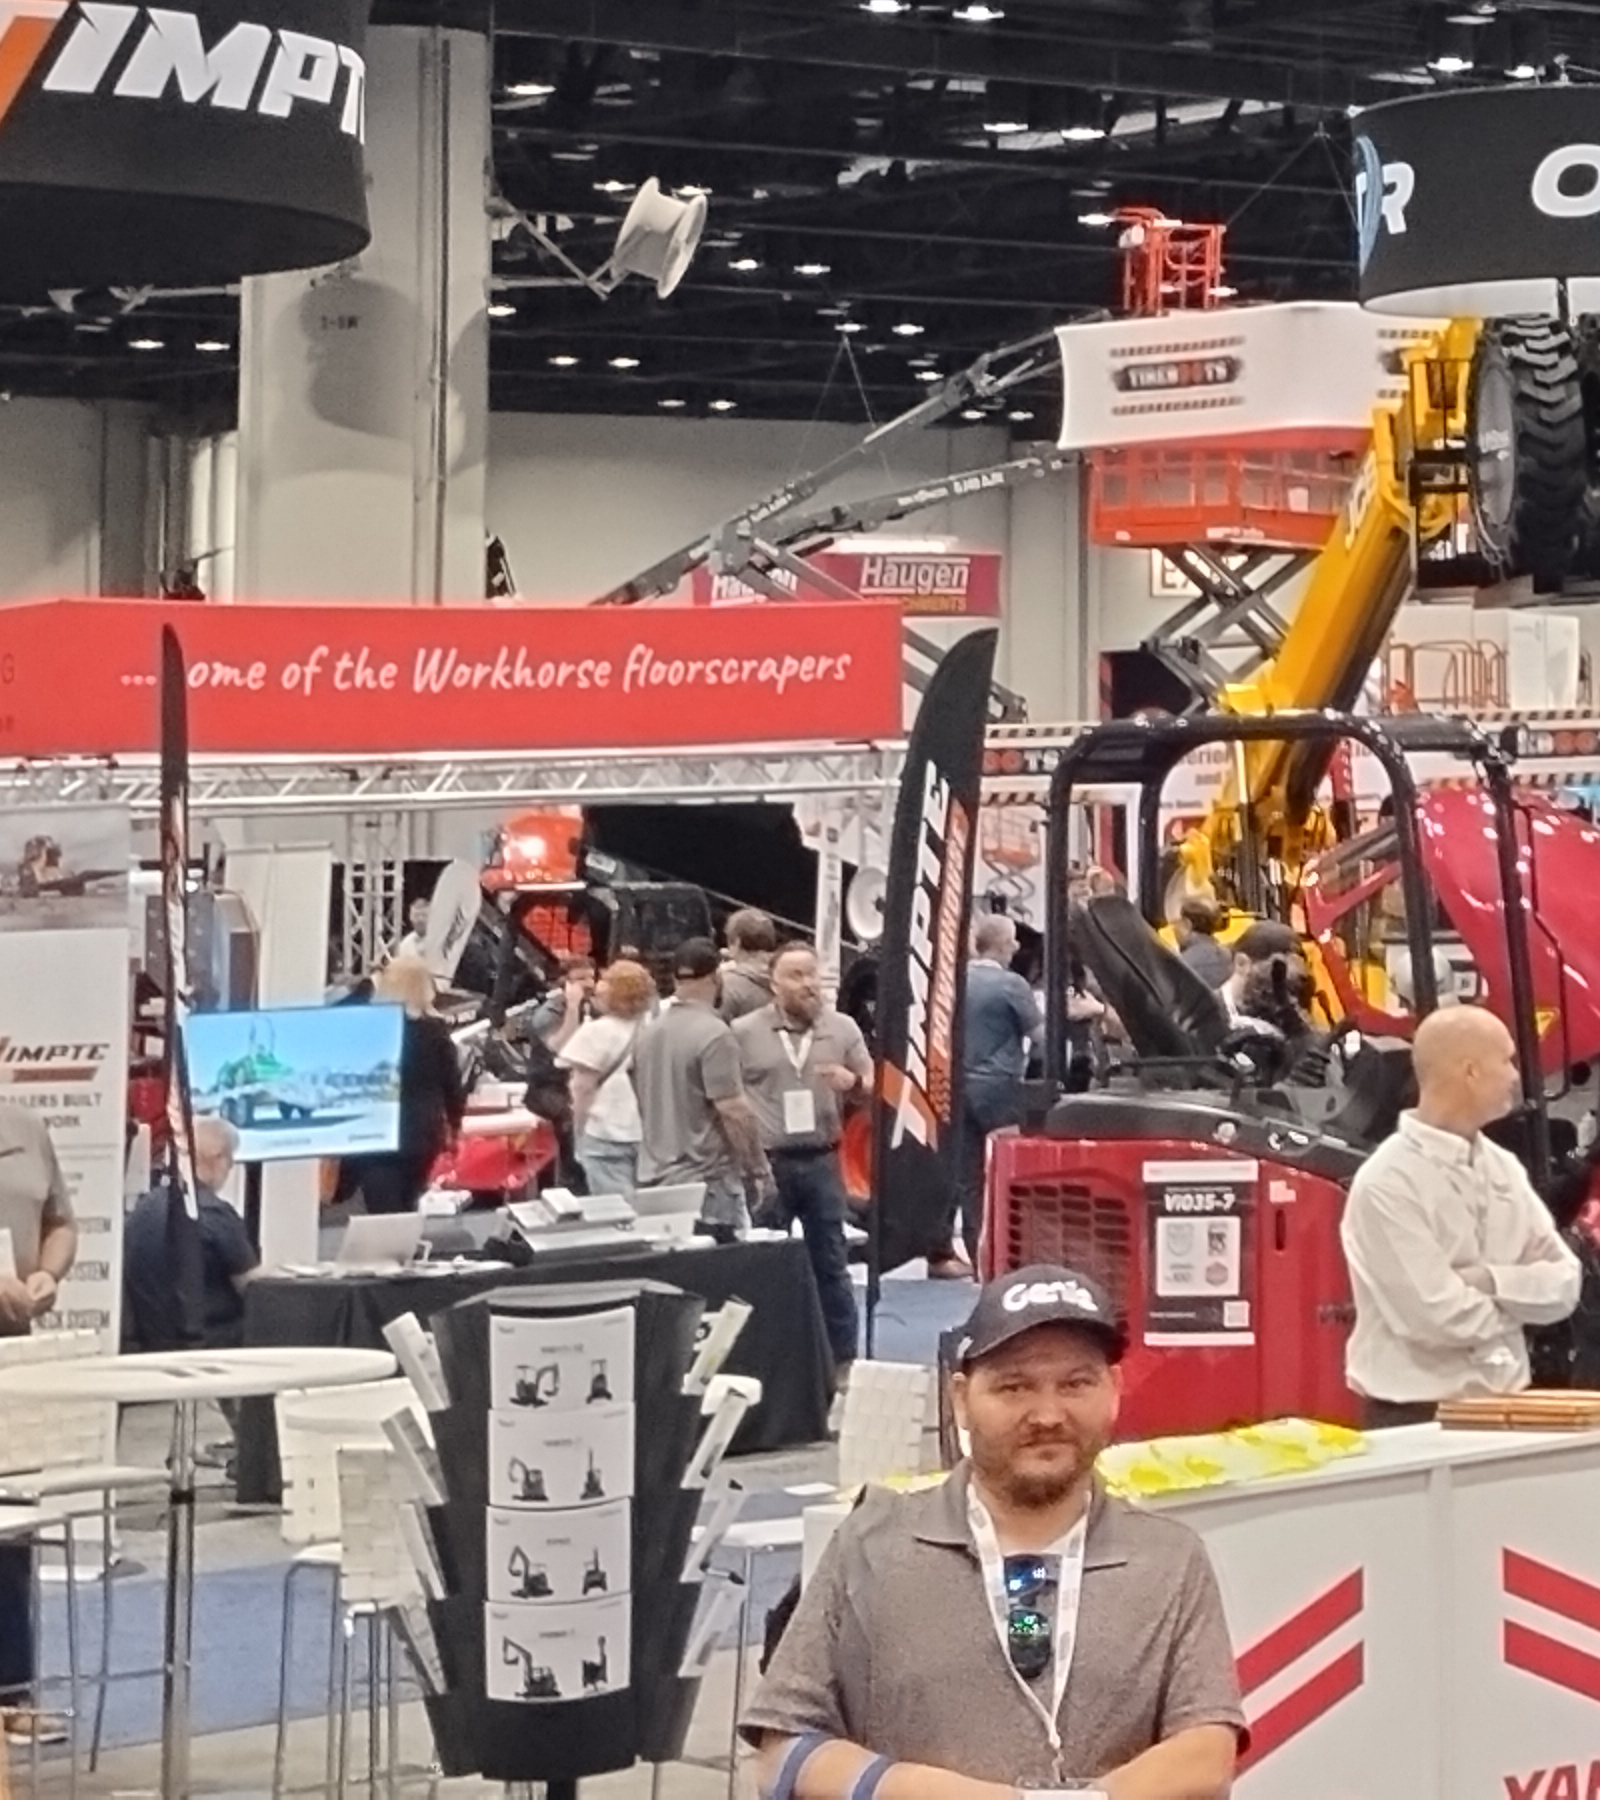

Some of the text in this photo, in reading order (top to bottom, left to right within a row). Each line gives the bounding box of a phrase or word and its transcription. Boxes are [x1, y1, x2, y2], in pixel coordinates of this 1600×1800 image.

[861, 557, 970, 594] Haugen
[281, 642, 329, 693] of
[334, 644, 397, 691] the
[412, 646, 611, 694] Workhorse
[623, 644, 853, 700] floorscrapers
[891, 760, 950, 1152] TIMPTE
[64, 1092, 103, 1107] BUILT
[1002, 1280, 1099, 1311] Genie
